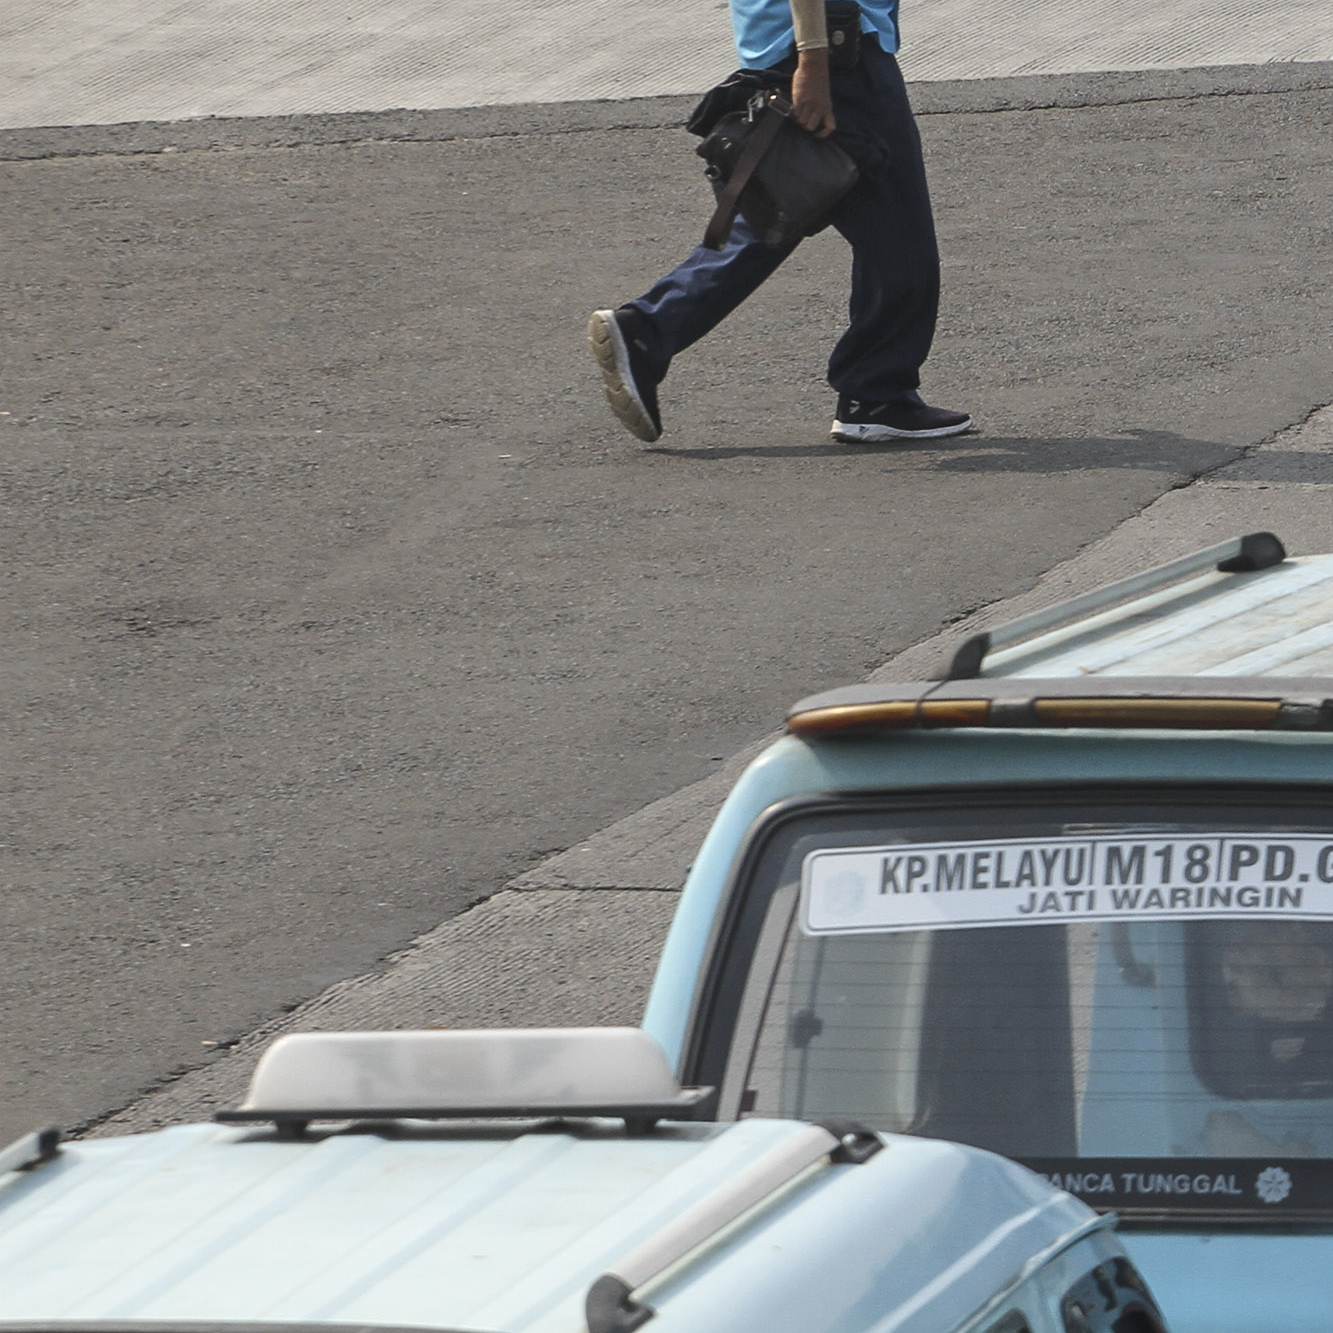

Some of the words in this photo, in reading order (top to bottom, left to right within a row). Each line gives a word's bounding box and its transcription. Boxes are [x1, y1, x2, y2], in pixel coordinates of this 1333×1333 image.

[878, 848, 1088, 894] KP.MELAYU
[1104, 844, 1210, 886] M18
[1018, 889, 1095, 915] JATI
[1111, 886, 1302, 911] WARINGIN
[1123, 1173, 1242, 1195] TUNGGAL
